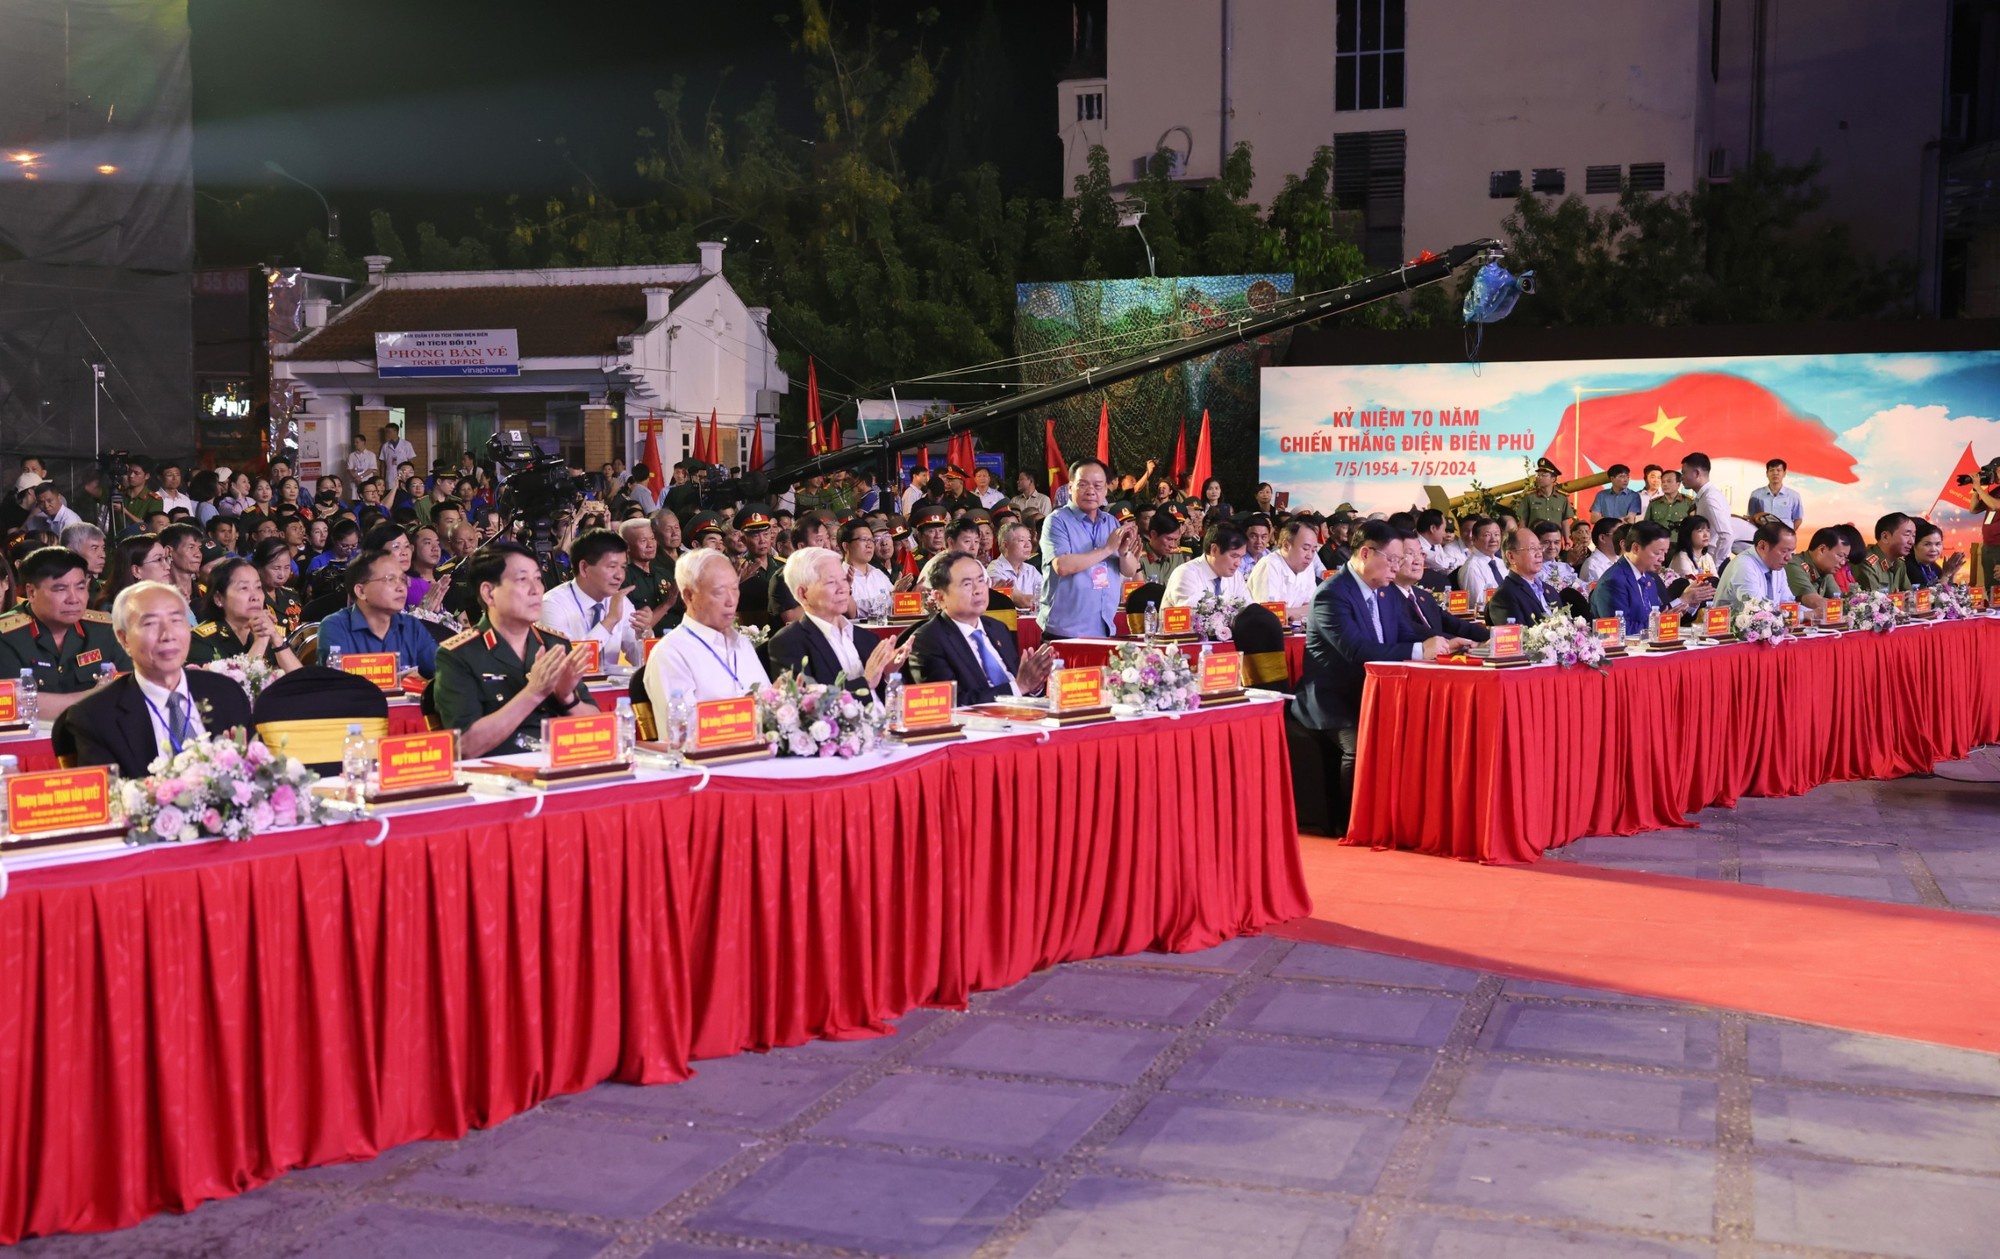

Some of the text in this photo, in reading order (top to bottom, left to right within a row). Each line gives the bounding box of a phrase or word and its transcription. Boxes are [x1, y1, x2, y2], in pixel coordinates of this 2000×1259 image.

[388, 347, 445, 358] PHÒNG
[450, 346, 482, 357] BÁN
[462, 366, 507, 374] vinaphone
[1333, 406, 1479, 430] KỶ NIỆM 70 NĂM
[1280, 428, 1535, 455] CHIẾN THẮNG ĐIỆN BIÊN PHỦ
[1335, 461, 1399, 477] 7/5/1954
[1411, 461, 1477, 476] 7/5/2024
[391, 751, 421, 766] HUỲNH
[16, 793, 37, 810] Thượng
[37, 792, 54, 806] tướng
[70, 787, 83, 802] VĂN
